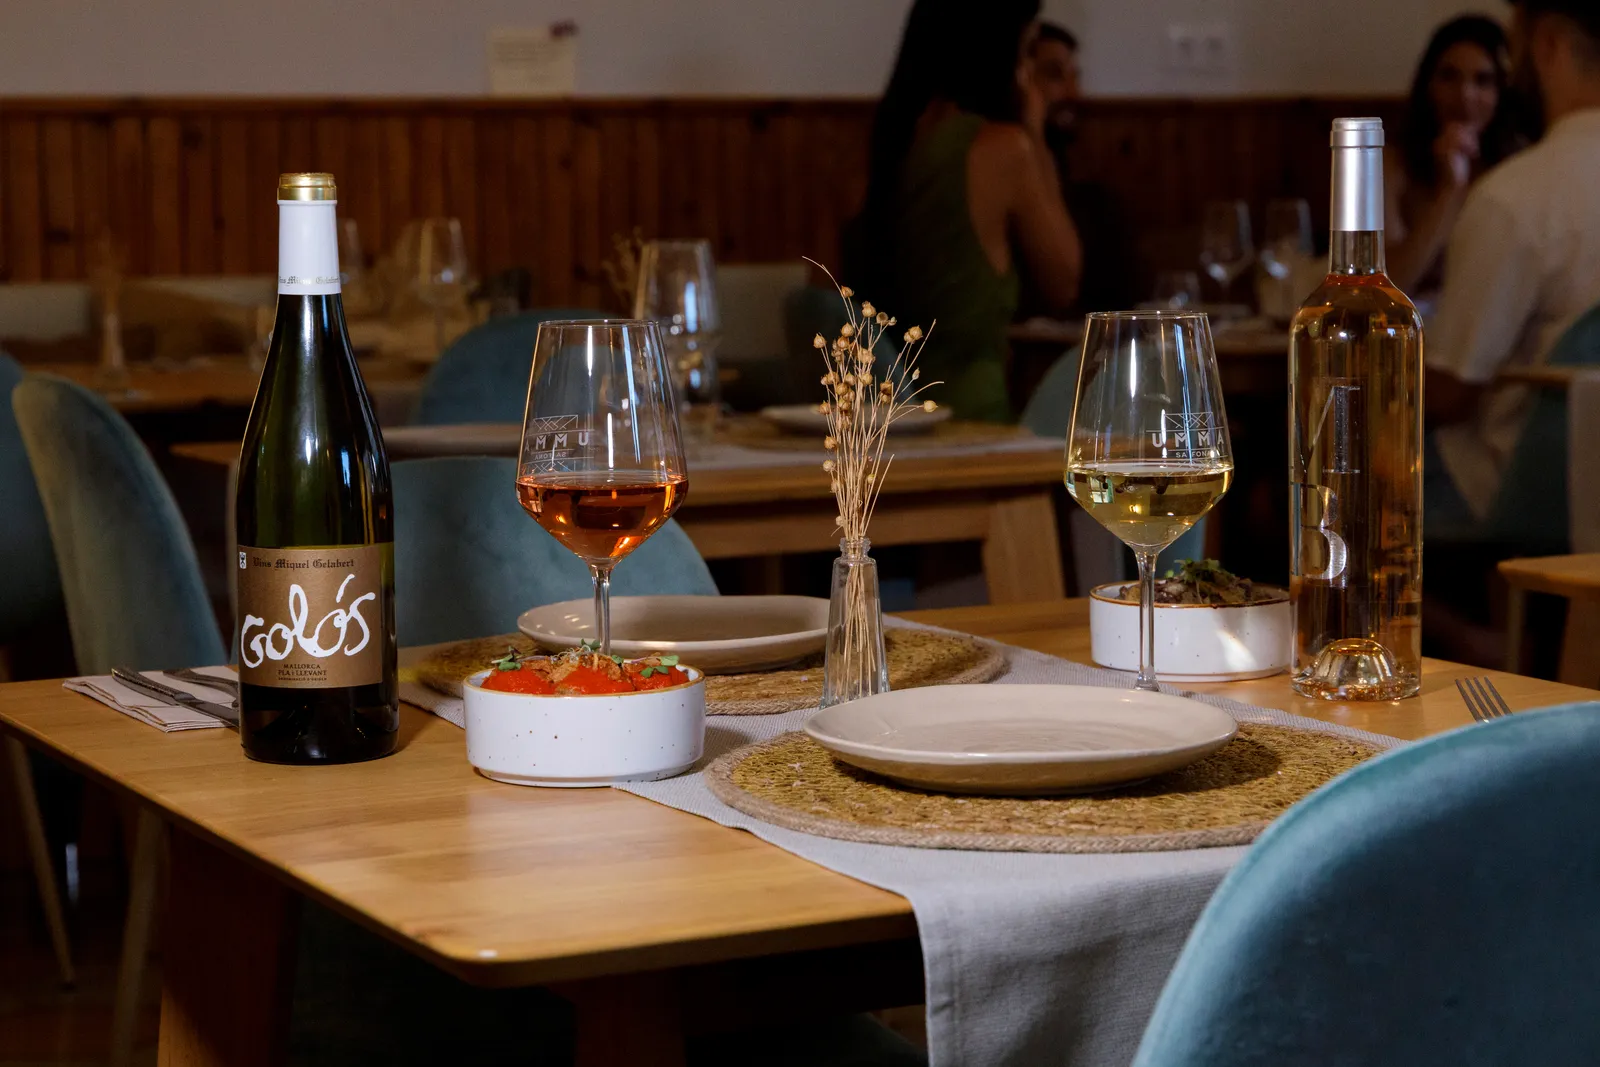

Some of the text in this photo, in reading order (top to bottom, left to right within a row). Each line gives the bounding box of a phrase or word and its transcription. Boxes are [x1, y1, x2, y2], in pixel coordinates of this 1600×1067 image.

[1152, 430, 1224, 448] UMMA
[253, 557, 354, 571] Vins Miquel Gelabert
